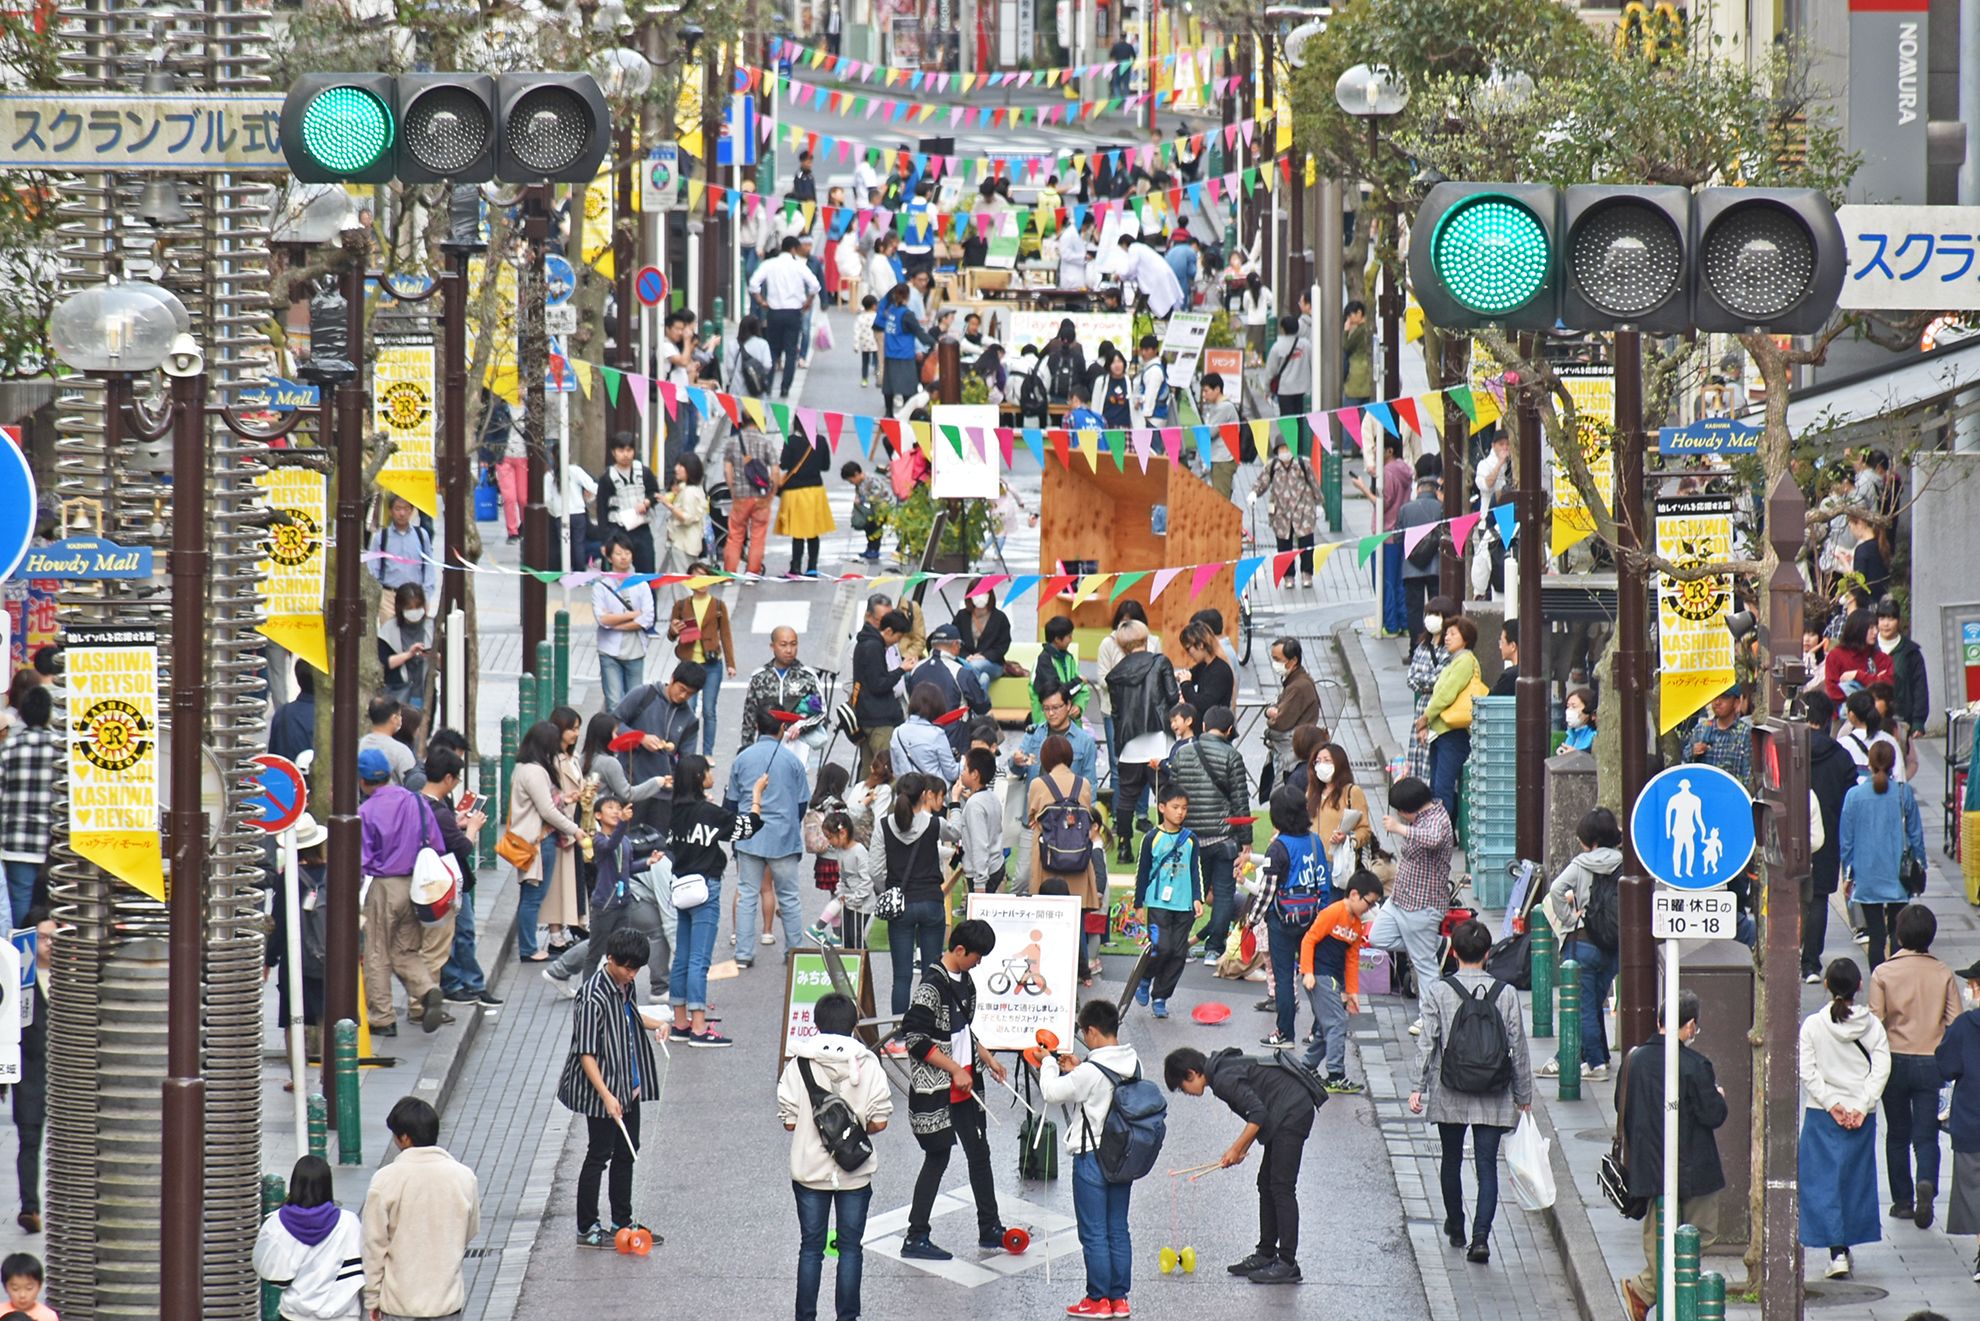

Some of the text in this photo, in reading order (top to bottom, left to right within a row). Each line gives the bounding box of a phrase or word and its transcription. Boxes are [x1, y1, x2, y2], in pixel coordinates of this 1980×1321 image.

[1898, 22, 1918, 125] NOMURA
[1854, 233, 1980, 282] スクラ
[1670, 431, 1765, 451] Howdy Mal
[272, 487, 324, 504] REYSOL
[1658, 519, 1729, 537] KASHIWA
[25, 552, 141, 575] Howdy Mall
[1662, 632, 1730, 651] KASHIWA
[70, 651, 154, 673] KASHIWA
[1679, 651, 1731, 670] REYSOL
[90, 674, 155, 694] REYSOL
[73, 786, 154, 807] KASHIWA
[95, 808, 153, 828] REYSOL
